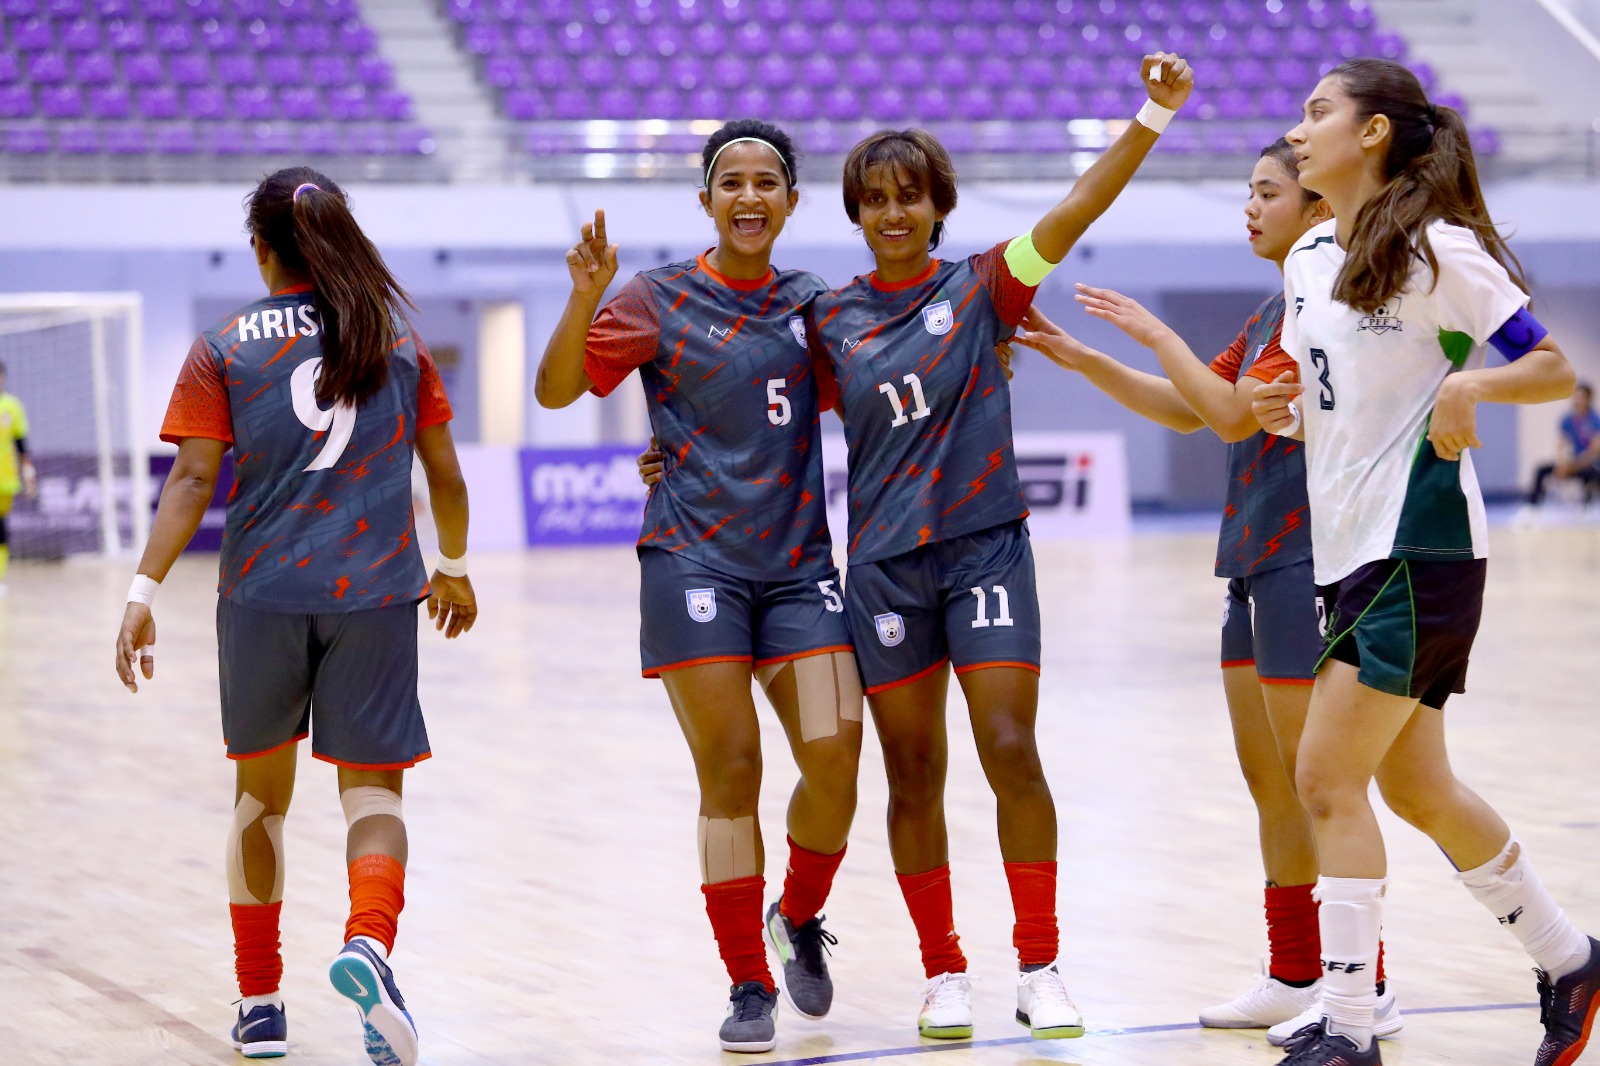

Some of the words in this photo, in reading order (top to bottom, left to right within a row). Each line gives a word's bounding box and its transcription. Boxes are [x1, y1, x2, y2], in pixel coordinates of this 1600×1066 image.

[238, 304, 326, 343] KRIS
[1368, 318, 1390, 326] PFF
[1501, 315, 1535, 349] C
[878, 372, 932, 428] 11
[1310, 348, 1335, 410] 3
[290, 356, 358, 472] 9
[766, 378, 792, 427] 5
[817, 580, 844, 613] 5
[970, 585, 1014, 628] 11
